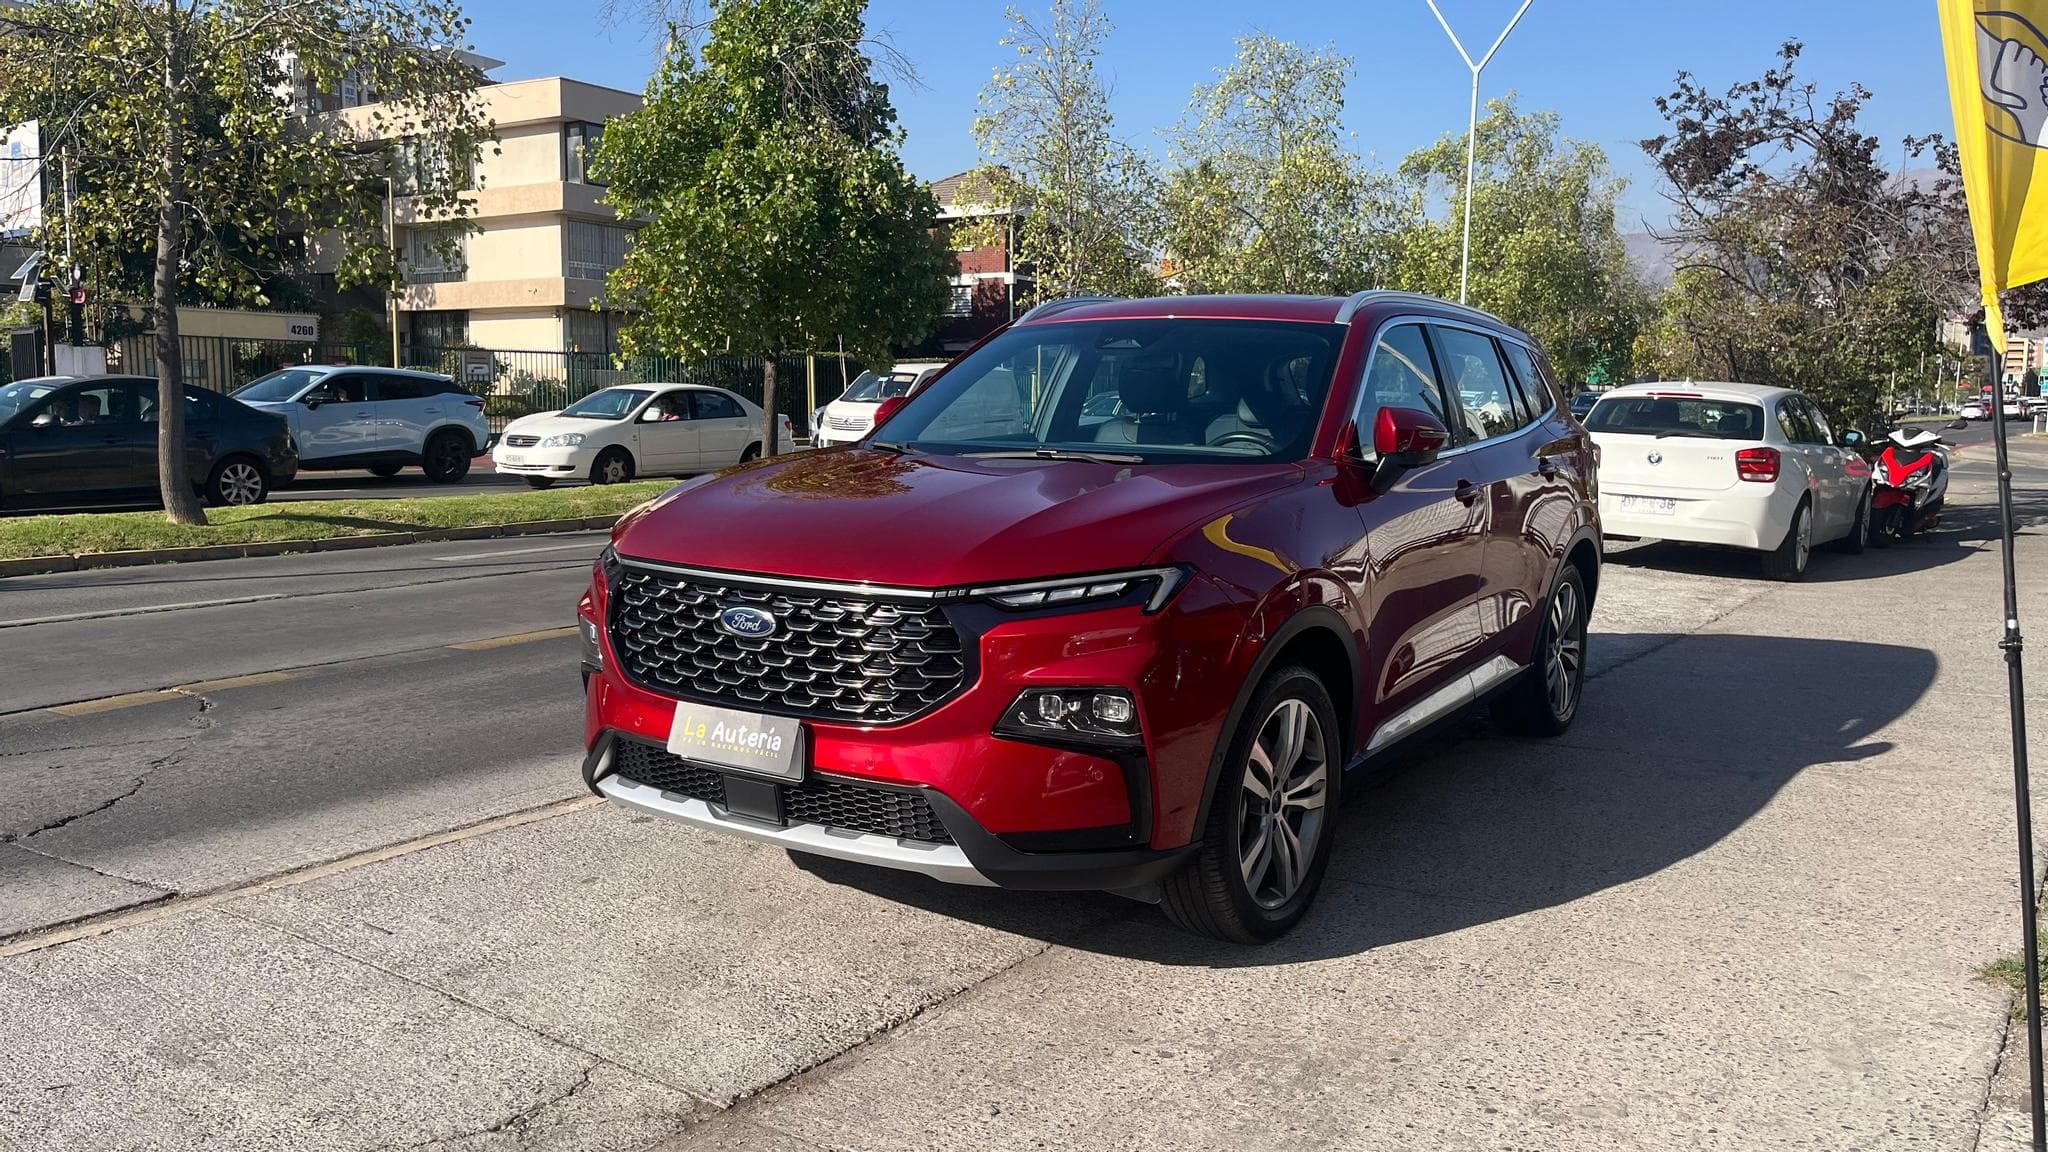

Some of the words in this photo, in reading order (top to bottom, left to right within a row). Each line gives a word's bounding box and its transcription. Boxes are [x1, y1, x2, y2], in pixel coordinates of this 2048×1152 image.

[291, 325, 314, 336] 4260
[732, 612, 762, 631] Ford
[684, 716, 706, 738] La
[711, 721, 782, 751] Autería
